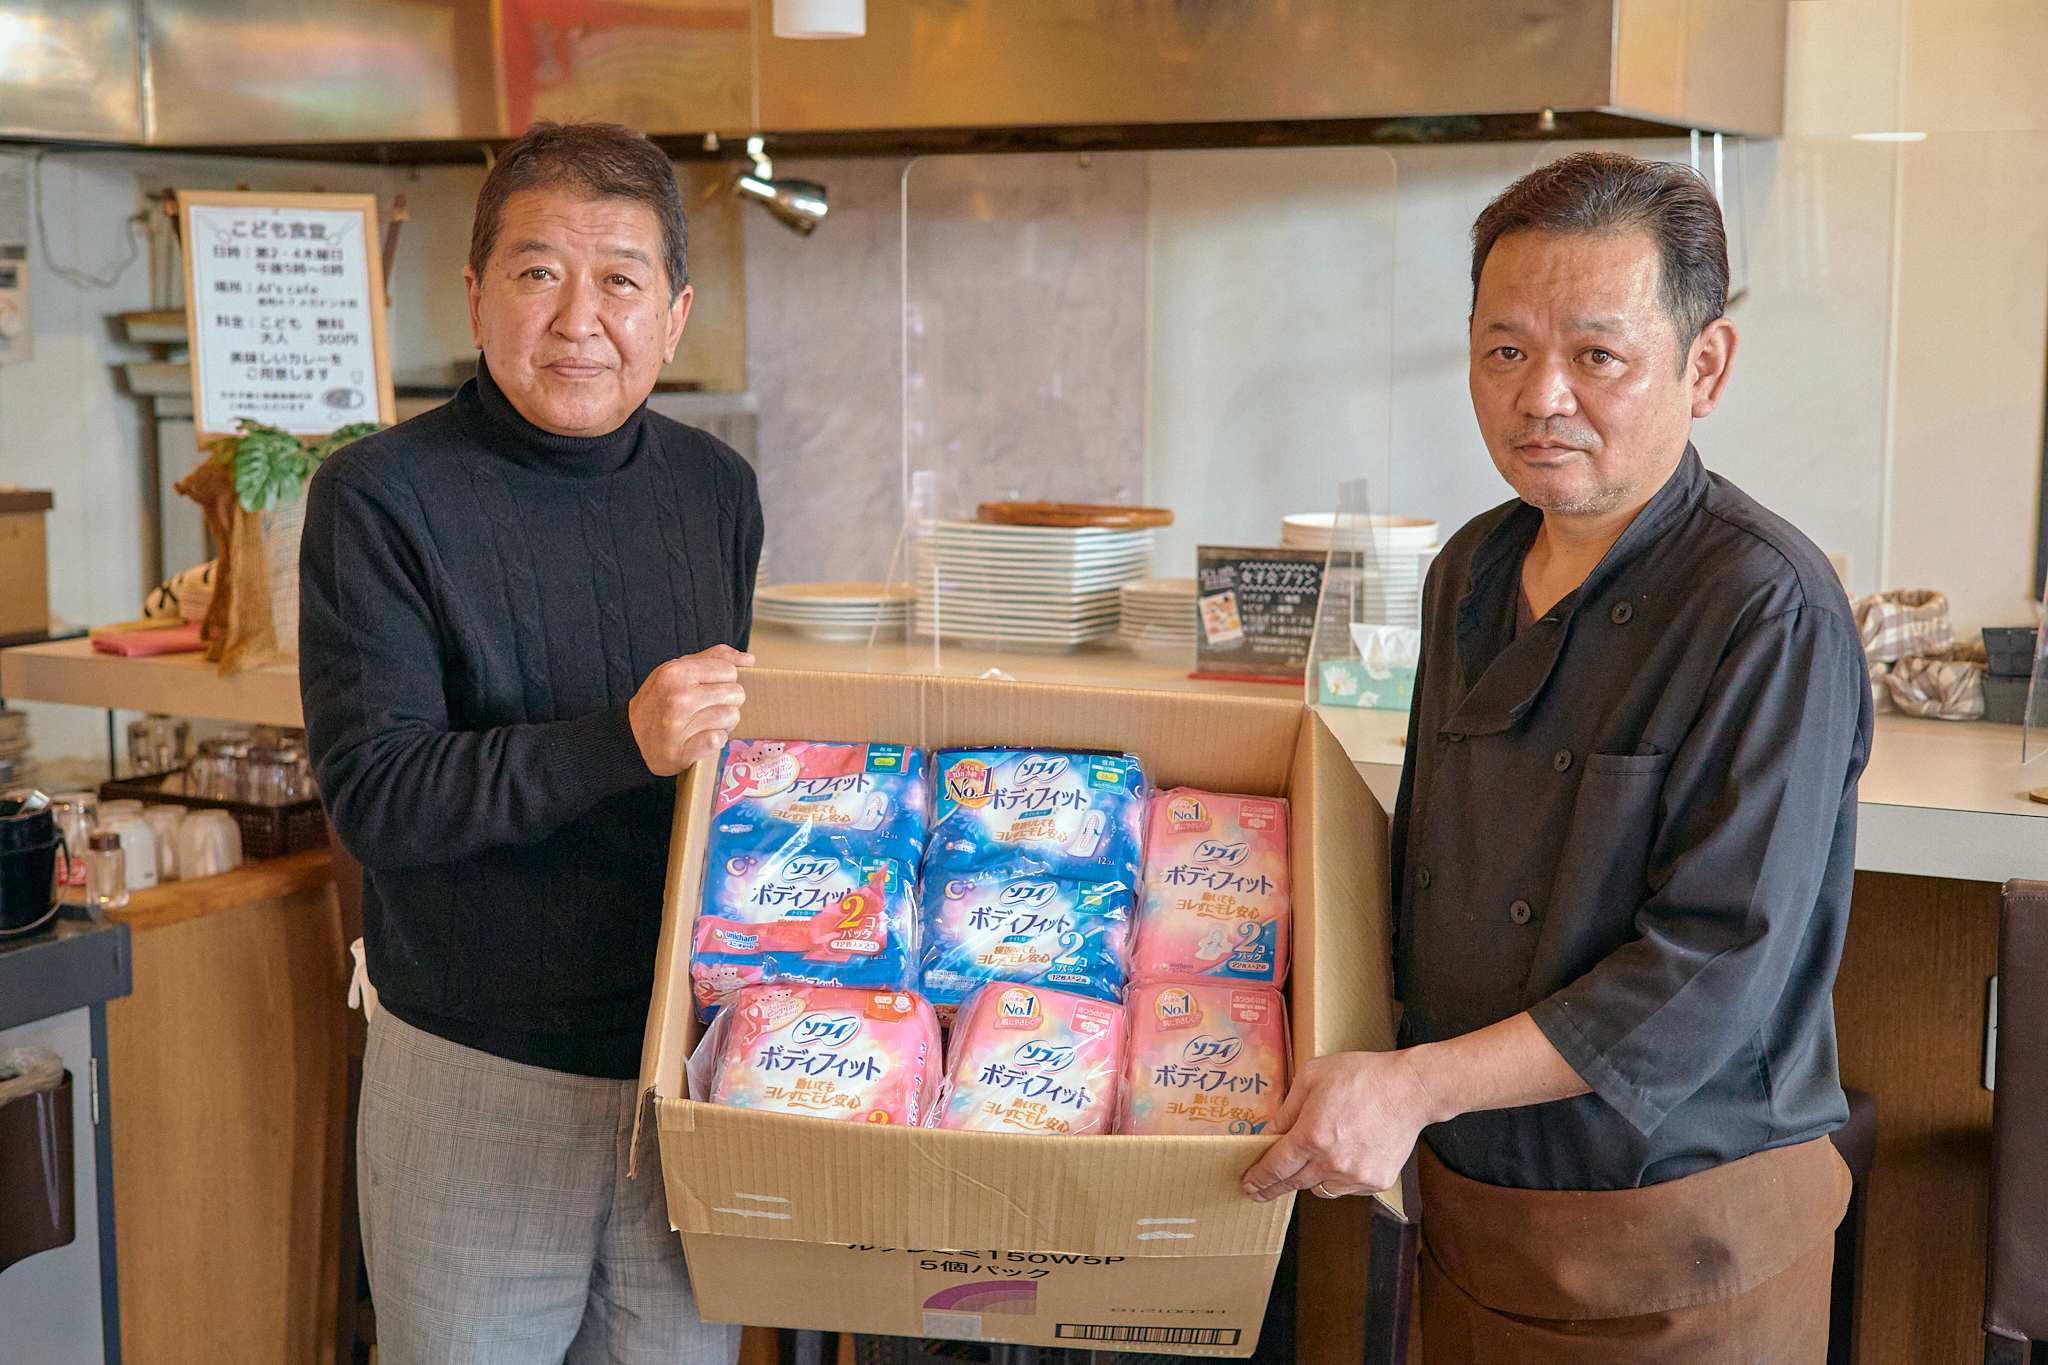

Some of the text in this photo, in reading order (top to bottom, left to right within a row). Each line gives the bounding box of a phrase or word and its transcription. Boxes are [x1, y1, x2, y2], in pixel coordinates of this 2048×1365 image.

[232, 220, 326, 239] こども食堂
[1023, 762, 1059, 776] ソフィ
[945, 766, 994, 800] No.1
[992, 787, 1087, 810] ボディフィット
[1173, 802, 1200, 821] No.1
[1174, 823, 1204, 831] 肌にやさしく
[1201, 844, 1239, 861] ソフィ
[790, 861, 829, 875] ソフィ
[1165, 864, 1274, 895] ボディフィット
[1010, 886, 1046, 901] ソフィ
[1201, 892, 1236, 905] 動いても
[1175, 899, 1260, 919] ヨレずにモレ安心
[969, 906, 1070, 934] ボディフィット
[726, 931, 758, 942] unicharm
[841, 928, 872, 939] パック
[977, 953, 1051, 965] ヨレモレ安心
[1237, 953, 1262, 961] パック
[1057, 964, 1083, 973] パック
[1002, 996, 1035, 1016] No.1
[1077, 1006, 1111, 1020] ふつうの日用
[1162, 994, 1190, 1017] No.1
[801, 1020, 848, 1039] ソフィ
[1001, 1018, 1035, 1026] 肌にやさしく
[1162, 1017, 1195, 1028] 肌にやさしく
[1023, 1045, 1063, 1066] ソフィ
[1192, 1042, 1232, 1058] ソフィ
[757, 1045, 881, 1081] ボディフィット
[794, 1078, 835, 1091] 動いても
[979, 1064, 1091, 1109] ボディフィット
[1155, 1064, 1268, 1095] ボディフィット
[763, 1086, 862, 1109] ヨレずにモレ安心
[1011, 1098, 1048, 1113] 動いても
[1193, 1093, 1230, 1107] 動いても
[982, 1101, 1070, 1133] ヨレずにモレ安心
[1166, 1101, 1255, 1120] ヨレずにモレ安心
[920, 1260, 1050, 1279] 5個パック
